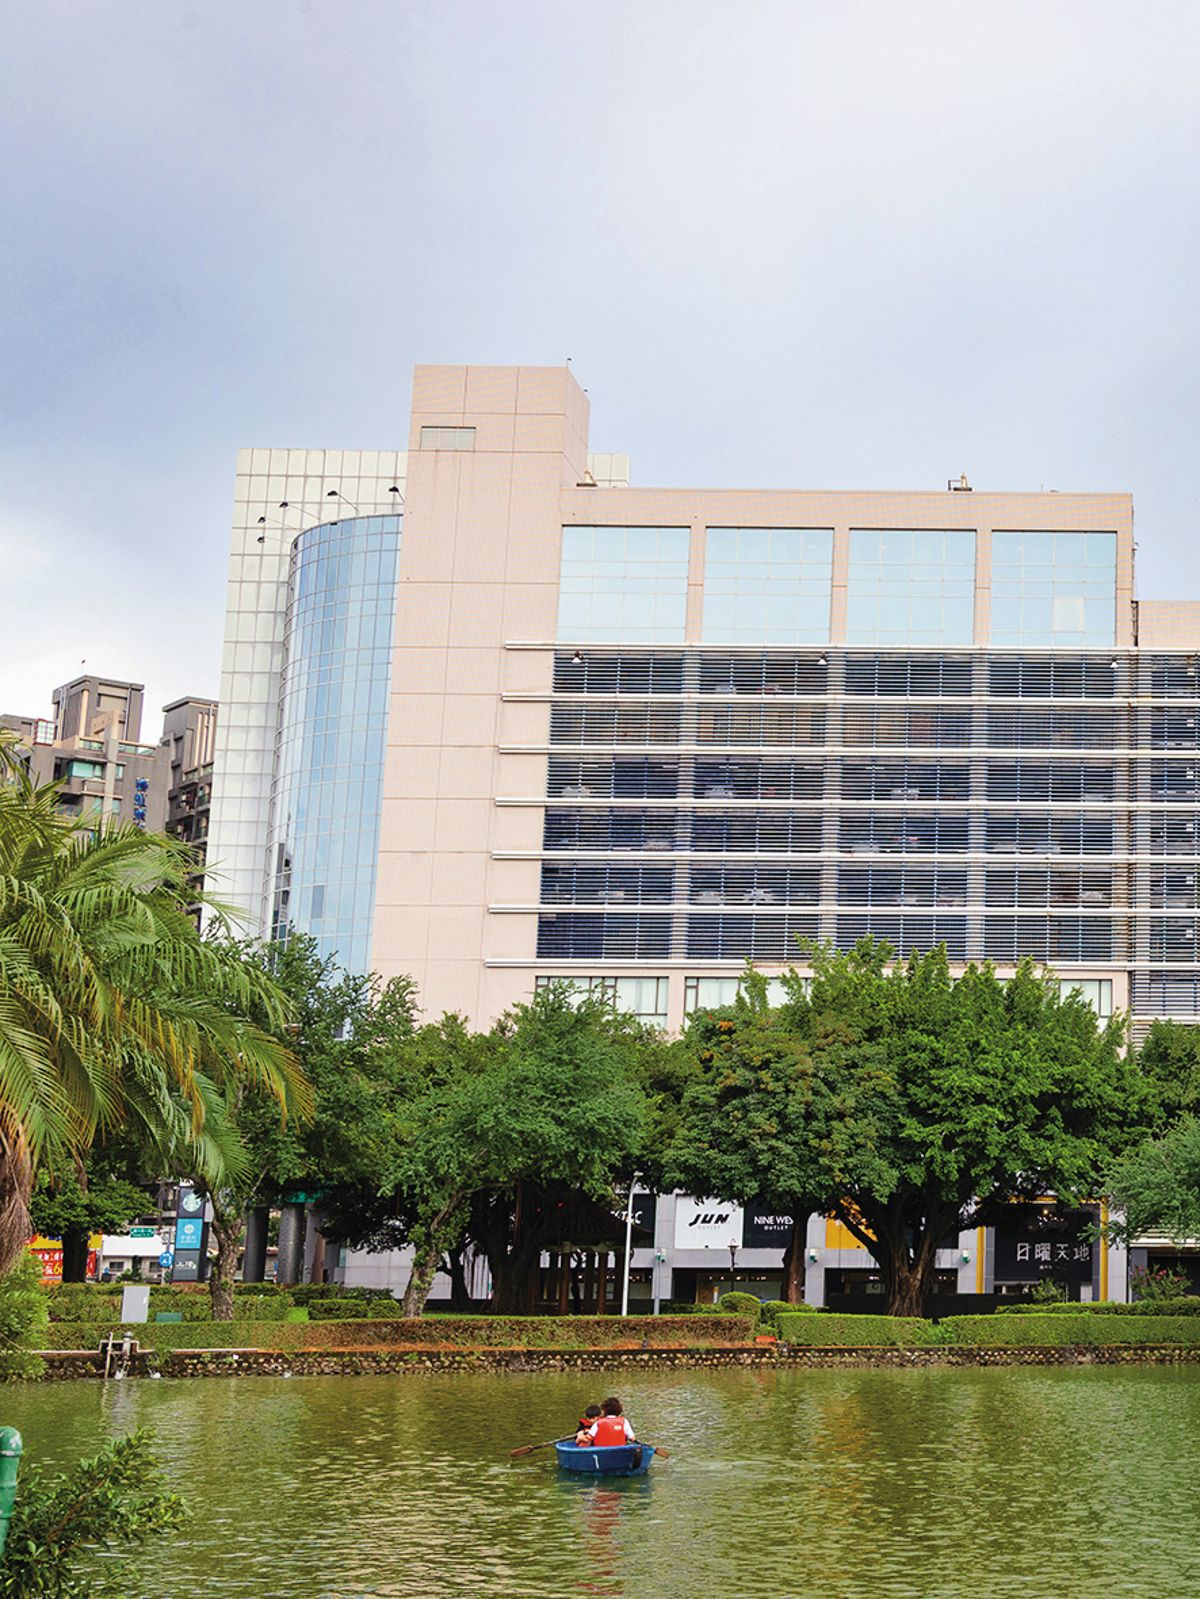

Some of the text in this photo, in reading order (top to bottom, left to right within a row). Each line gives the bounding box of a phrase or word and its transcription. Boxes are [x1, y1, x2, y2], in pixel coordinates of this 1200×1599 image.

[688, 1213, 729, 1227] JUN
[753, 1215, 774, 1224] NINE
[1016, 1242, 1090, 1261] 日曜天地
